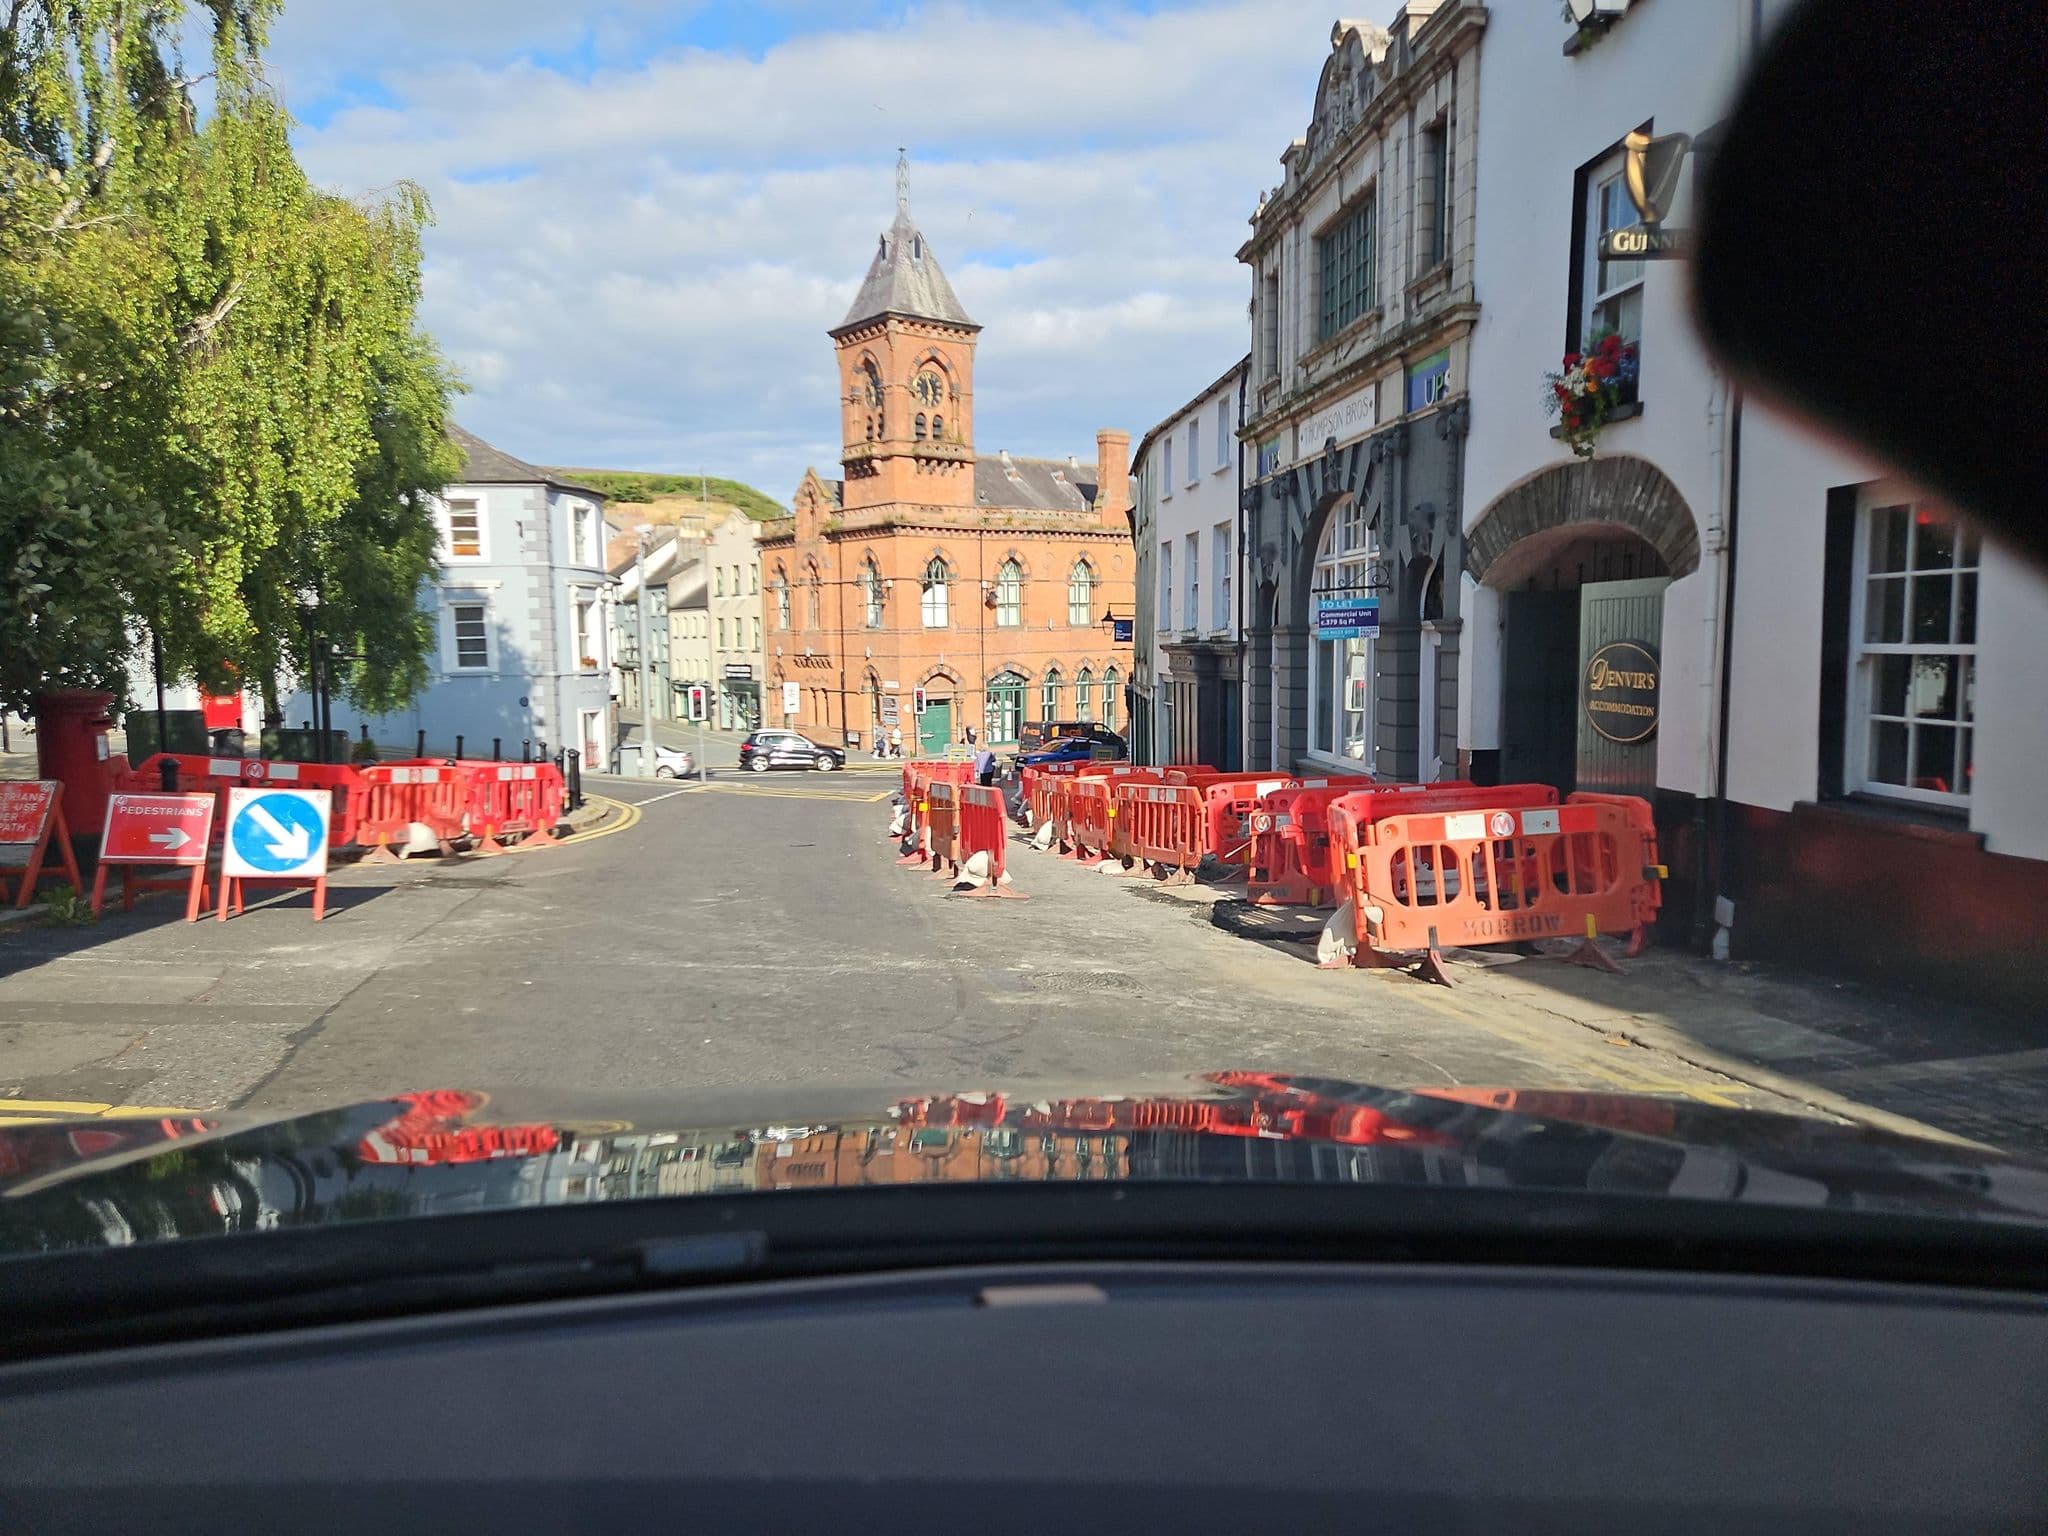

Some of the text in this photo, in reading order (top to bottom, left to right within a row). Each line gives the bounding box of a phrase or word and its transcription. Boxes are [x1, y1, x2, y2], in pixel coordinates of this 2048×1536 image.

[1303, 396, 1369, 444] THOMPSON BROS
[1320, 610, 1358, 618] Commercial
[1589, 700, 1655, 717] ACCOMMODATION
[119, 806, 204, 817] PEDESTRIANS
